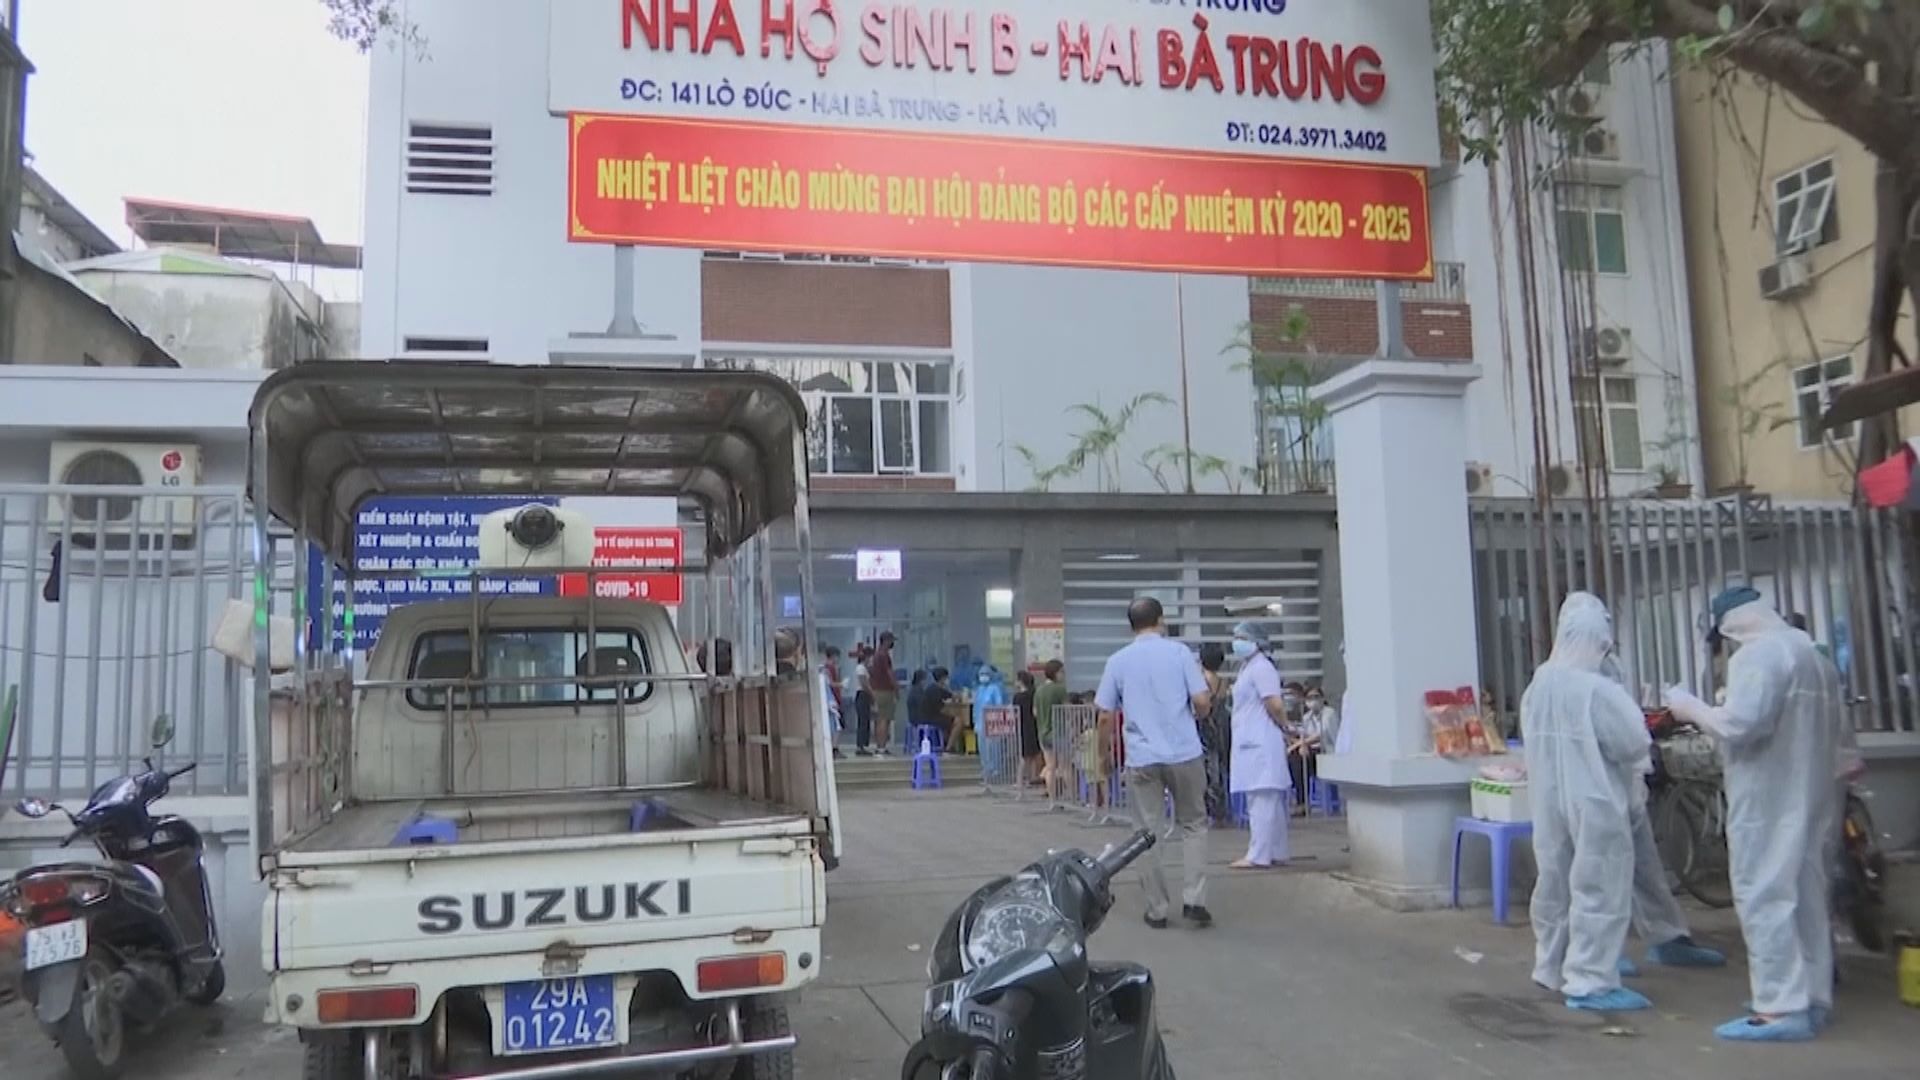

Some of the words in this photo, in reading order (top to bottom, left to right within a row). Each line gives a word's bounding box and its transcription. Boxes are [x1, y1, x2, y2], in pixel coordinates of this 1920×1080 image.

[859, 4, 977, 73] SINH
[991, 12, 1020, 75] B
[1057, 19, 1143, 87] HAI
[1156, 12, 1224, 94] BÀ
[1226, 34, 1386, 106] TRƯNG
[620, 78, 663, 103] ĐC:
[671, 82, 701, 105] 141
[706, 77, 736, 107] LÒ
[743, 81, 793, 111] ĐÚC
[811, 90, 850, 117] HAI
[854, 88, 884, 118] BÀ
[977, 97, 1011, 126] HÀ
[1016, 101, 1057, 132] NỘI
[1226, 122, 1255, 143] ĐT:
[1258, 124, 1388, 151] 024.3971.3402
[597, 152, 671, 211] NHIỆT
[678, 156, 729, 214] LIỆT
[735, 160, 801, 209] CHÀO
[808, 162, 881, 213] MỪNG
[887, 175, 926, 225] ĐẠI
[933, 171, 972, 228] HỘI
[978, 166, 1042, 223] ĐẢNG
[1047, 179, 1079, 235] BỘ
[1084, 179, 1129, 228] CÁC
[1135, 179, 1180, 231] CẤP
[1184, 187, 1255, 243] NHIỆM
[1260, 190, 1287, 236] KỲ
[1292, 200, 1344, 239] 2020
[1361, 203, 1412, 242] 2025
[161, 475, 180, 487] LG
[595, 580, 649, 598] COVID-19
[417, 878, 692, 936] SUZUKI
[531, 978, 589, 1011] 29A
[507, 1007, 612, 1048] 012.42
